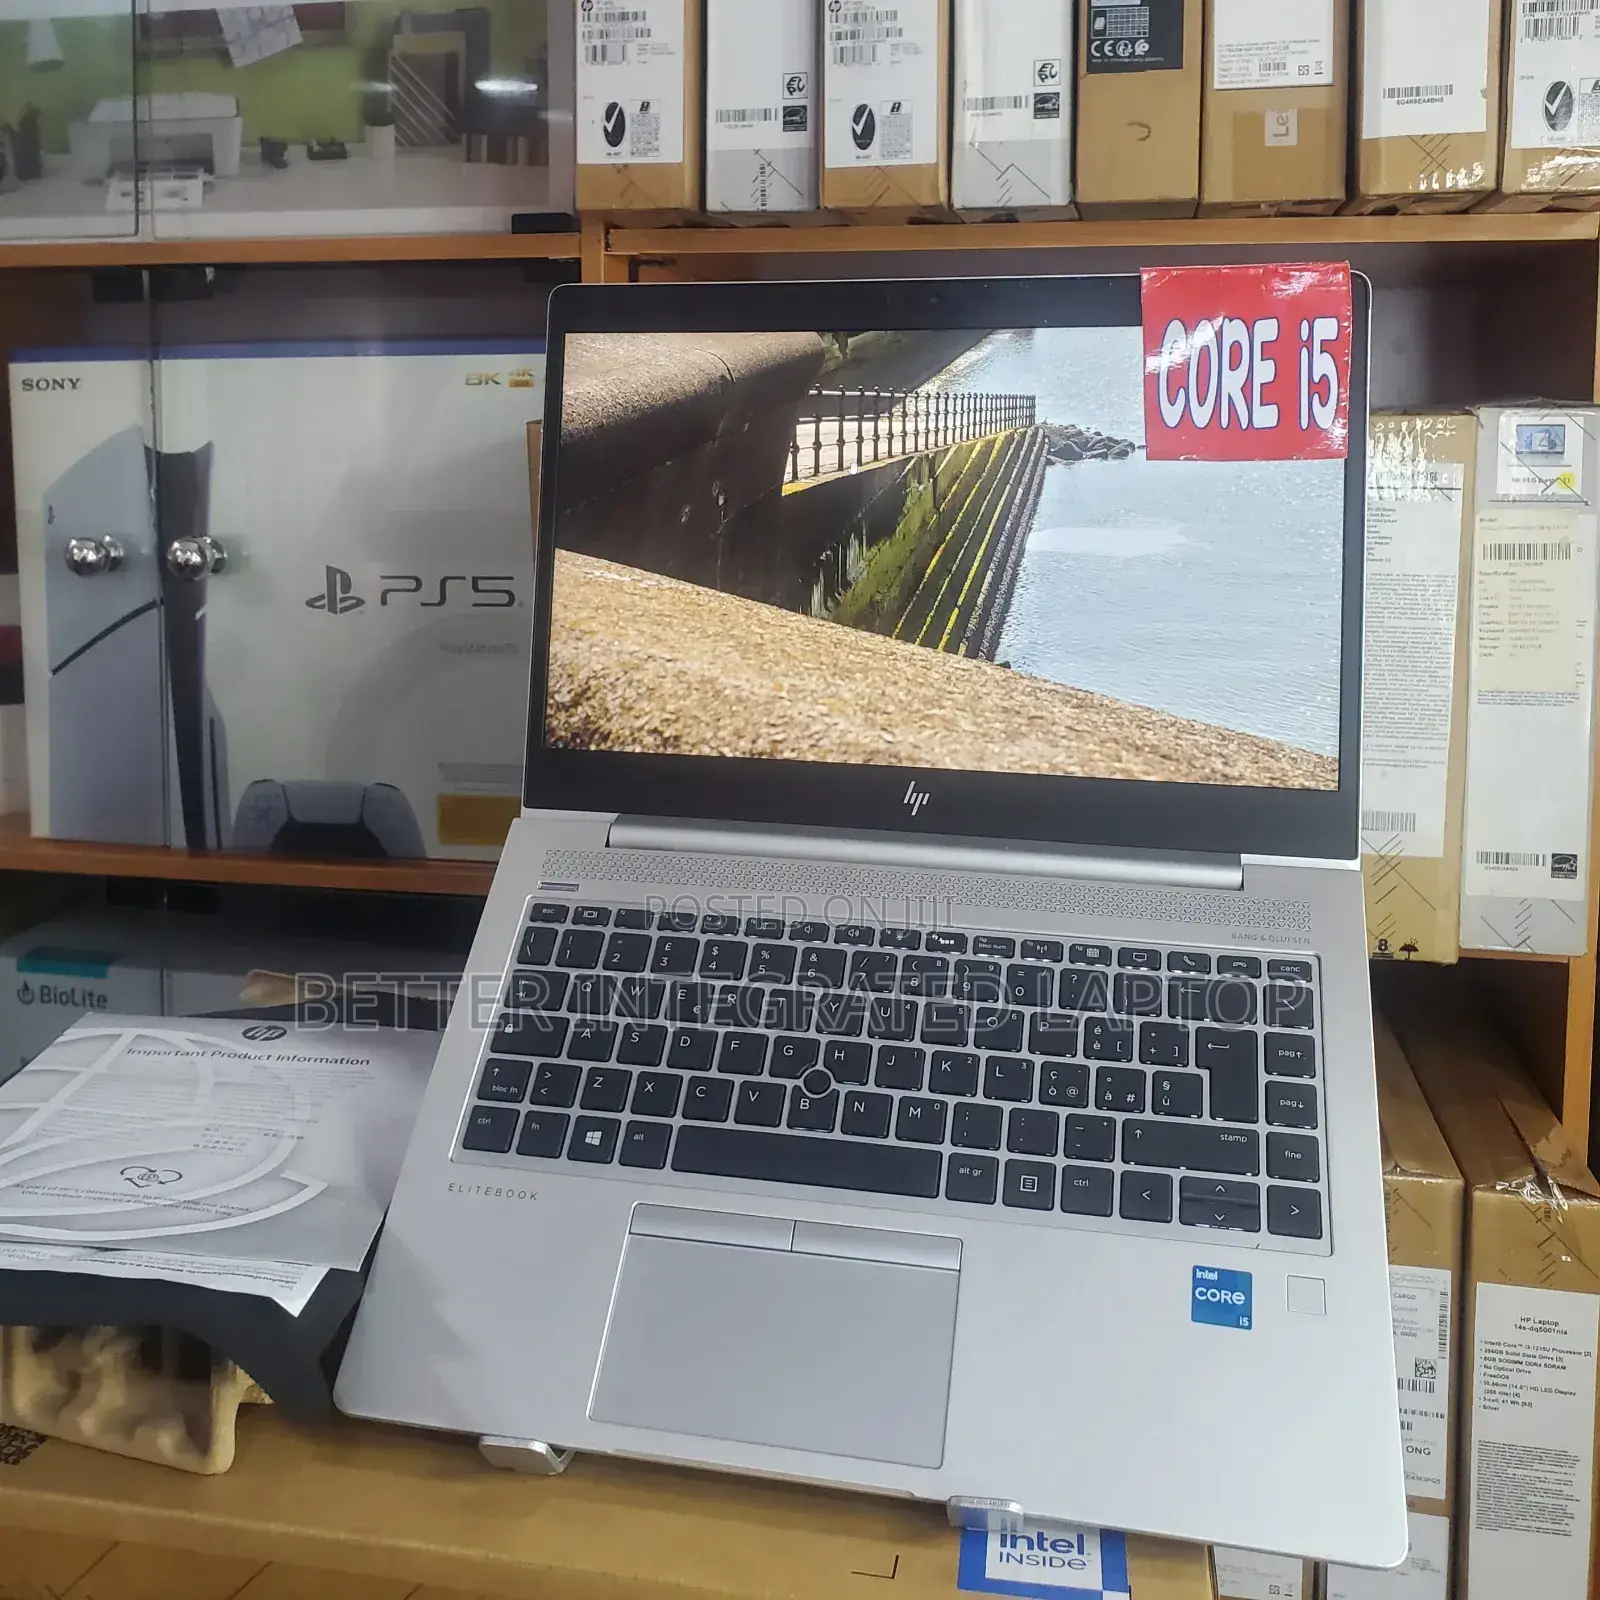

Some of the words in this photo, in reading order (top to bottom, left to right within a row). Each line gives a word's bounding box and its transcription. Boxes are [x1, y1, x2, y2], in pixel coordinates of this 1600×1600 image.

[1158, 316, 1280, 430] CORE
[1299, 317, 1340, 431] i5
[21, 378, 81, 392] SONY
[380, 575, 516, 608] PS5
[903, 780, 930, 816] hp
[1231, 932, 1258, 941] BANG
[1260, 934, 1266, 942] &
[1268, 934, 1310, 945] OLUFSEN
[1378, 939, 1388, 951] 8
[611, 953, 621, 963] 2
[660, 956, 669, 967] 3
[708, 960, 718, 970] 4
[758, 964, 767, 974] 5
[1280, 964, 1300, 973] canc
[807, 968, 816, 978] 6
[910, 977, 919, 987] 8
[963, 982, 971, 992] 9
[39, 984, 109, 1009] BioLite
[127, 1047, 207, 1058] Important
[210, 1049, 273, 1062] Product
[276, 1053, 371, 1066] Information
[477, 1116, 491, 1125] ctrl
[531, 1122, 540, 1131] fn
[633, 1132, 645, 1141] alt
[1219, 1133, 1248, 1144] stamp
[1284, 1150, 1302, 1160] fine
[958, 1166, 970, 1175] alt
[972, 1168, 983, 1176] gr
[1073, 1179, 1089, 1187] ctrl
[448, 1182, 538, 1201] ELITEBOOK
[1196, 1269, 1218, 1281] intel
[1520, 1316, 1532, 1324] HP
[1533, 1317, 1560, 1327] Laptop
[1552, 1347, 1583, 1356] Processor
[1000, 1528, 1085, 1556] intel
